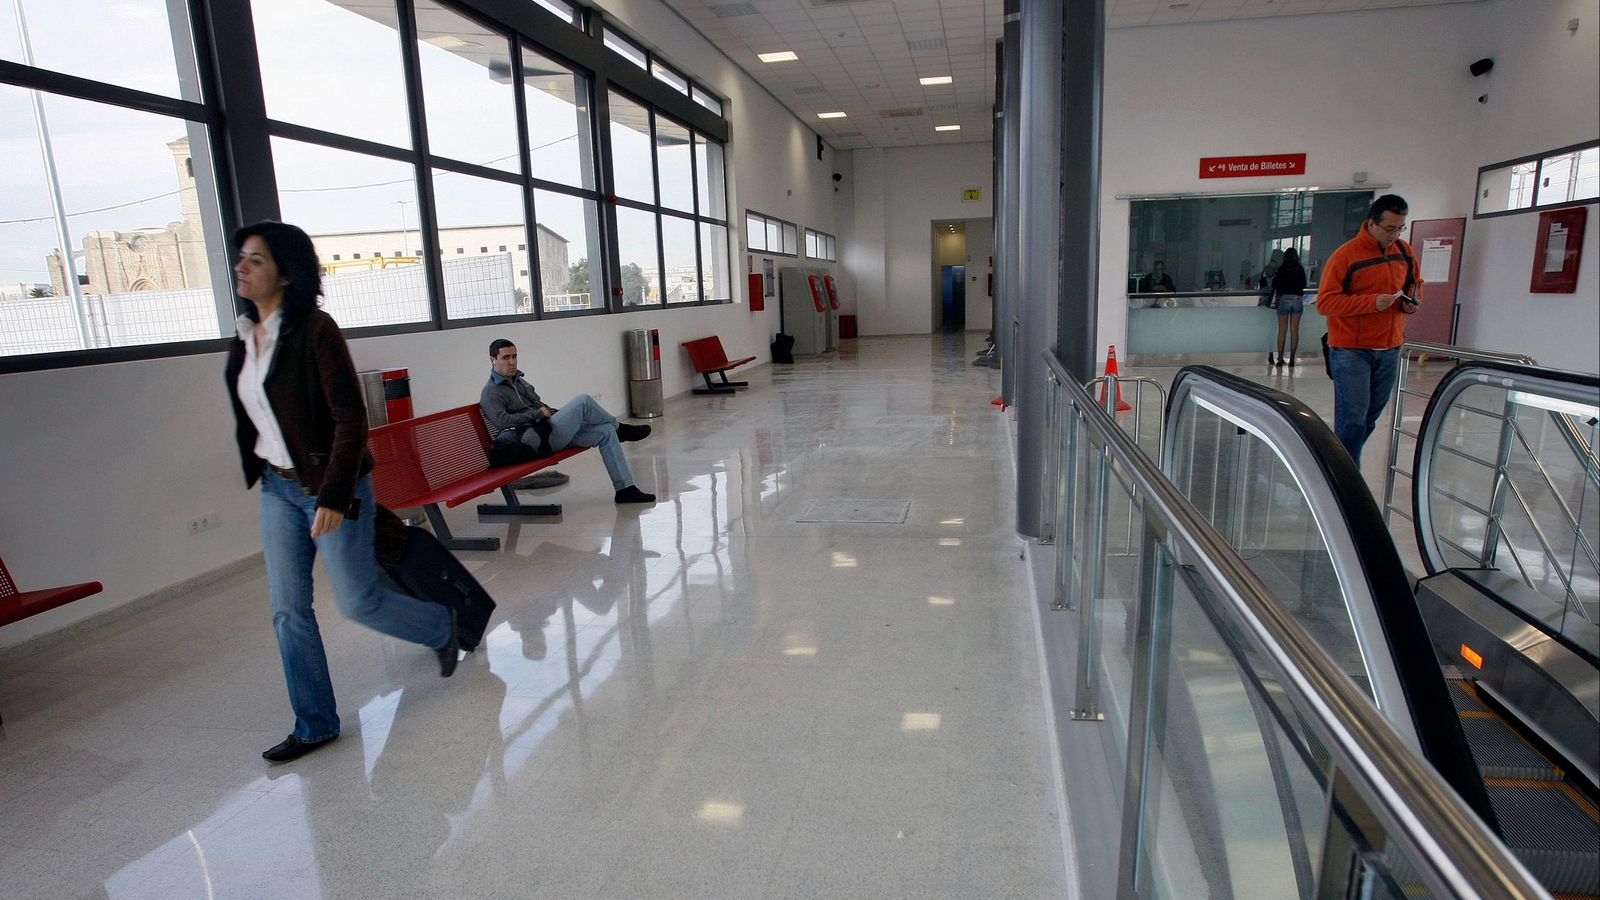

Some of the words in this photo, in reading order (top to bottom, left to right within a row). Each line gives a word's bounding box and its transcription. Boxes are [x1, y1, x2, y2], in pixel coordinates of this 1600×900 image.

[1228, 163, 1248, 172] Venta
[1250, 162, 1259, 170] de
[1260, 161, 1287, 170] Billetes
